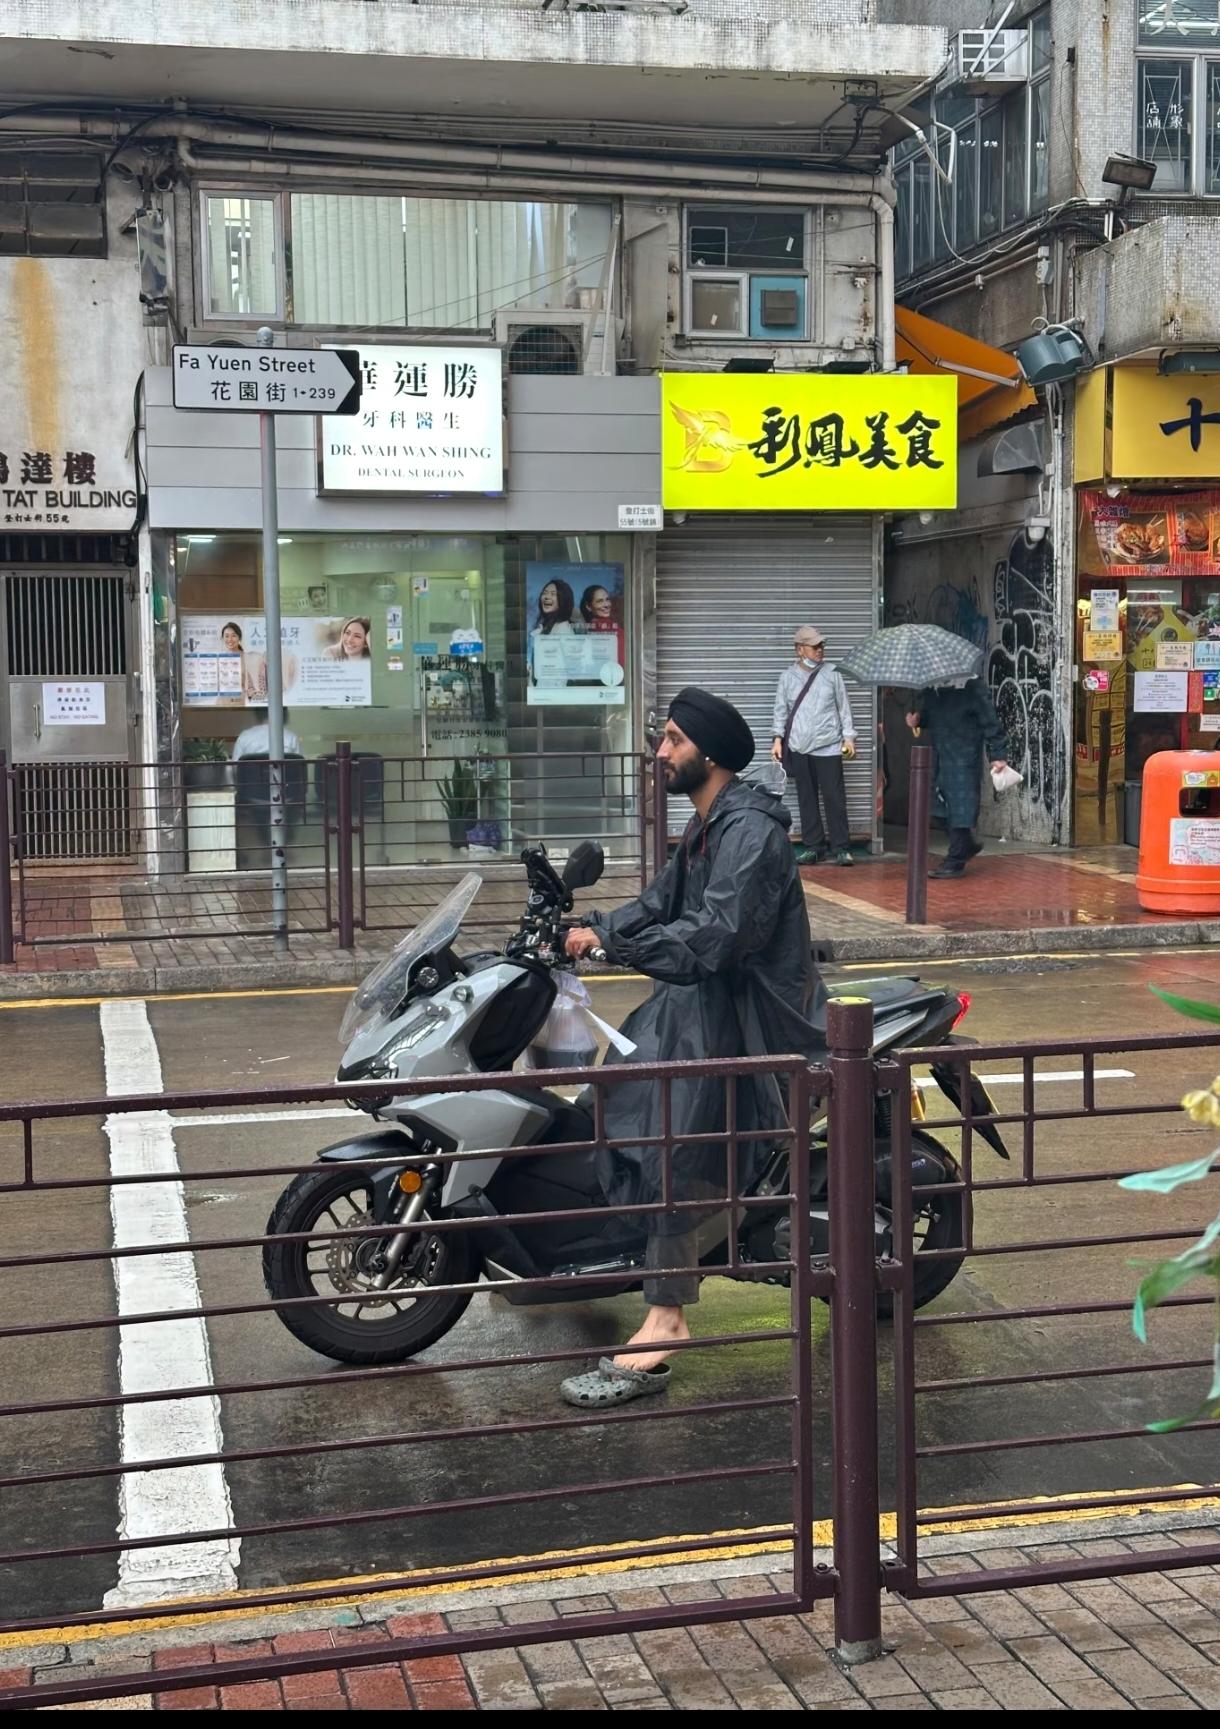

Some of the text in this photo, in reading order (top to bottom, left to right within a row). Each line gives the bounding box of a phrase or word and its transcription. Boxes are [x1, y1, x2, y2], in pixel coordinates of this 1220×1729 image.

[179, 353, 316, 373] Fa Yuen Street
[210, 380, 286, 402] 花園街
[363, 410, 461, 430] 牙科醫生
[330, 443, 492, 459] DR. WAH WAN SHING
[358, 467, 465, 479] DENTAL SURGEON
[2, 489, 137, 509] TAT BUILDING
